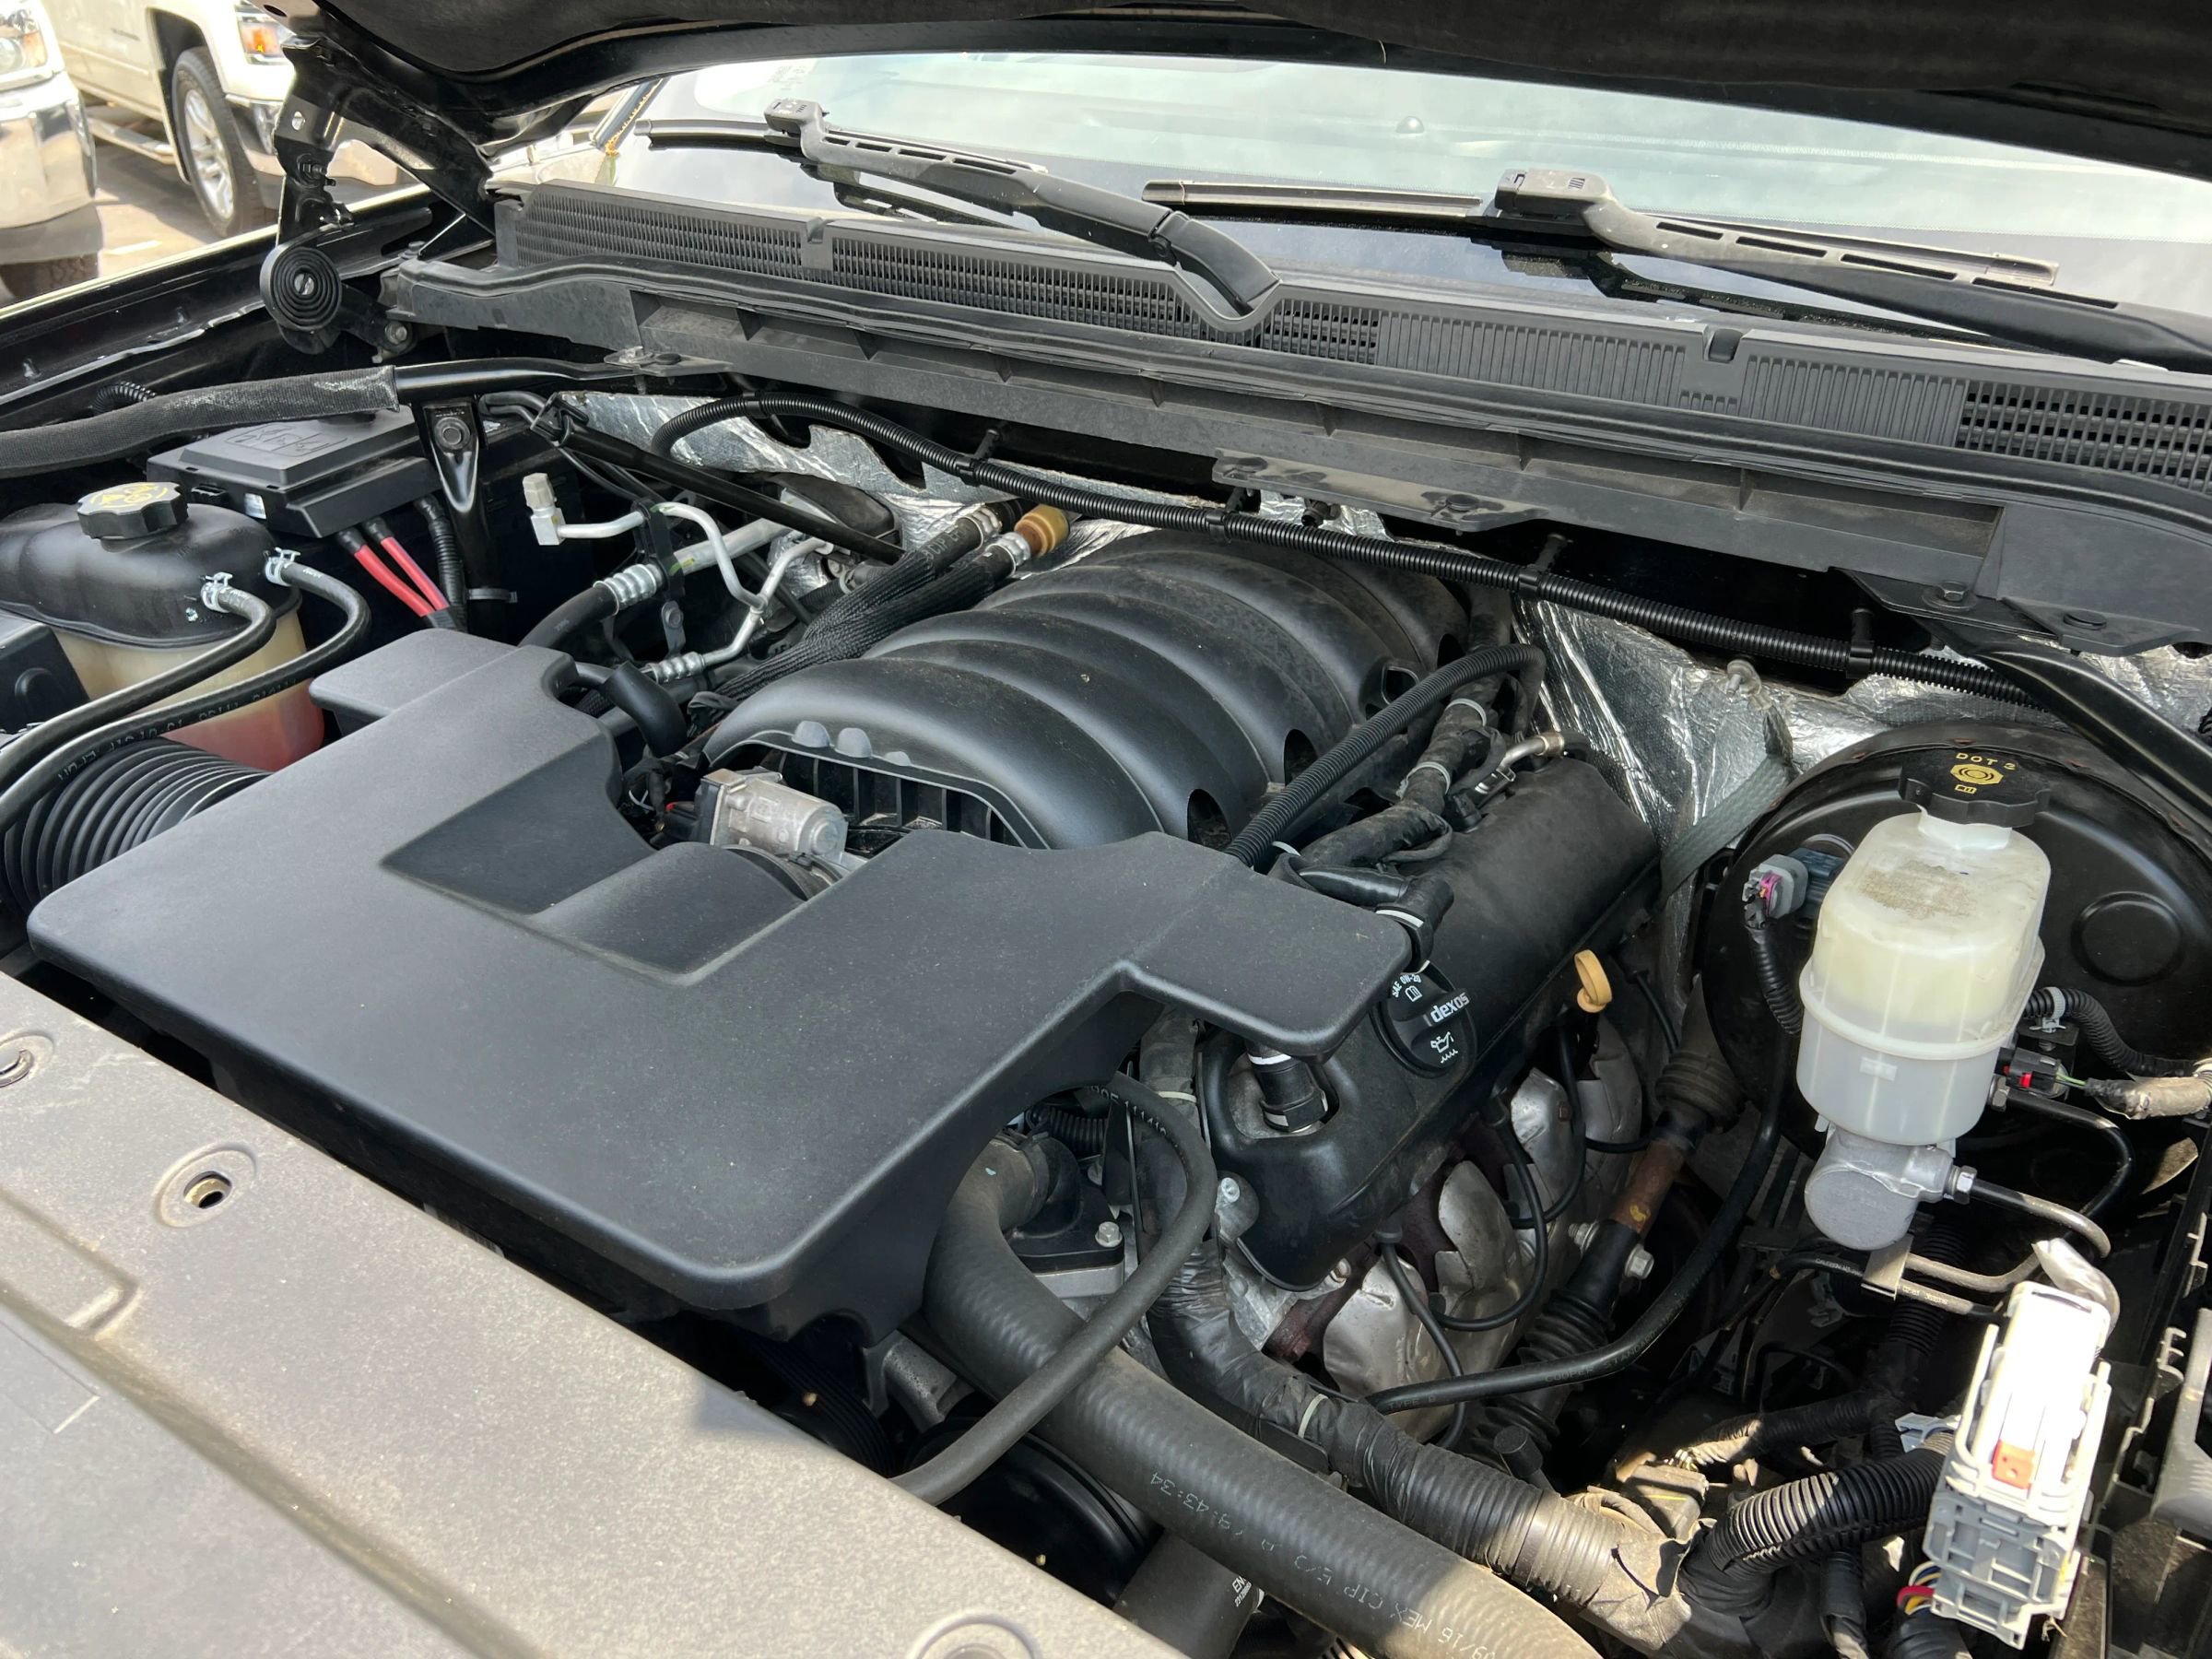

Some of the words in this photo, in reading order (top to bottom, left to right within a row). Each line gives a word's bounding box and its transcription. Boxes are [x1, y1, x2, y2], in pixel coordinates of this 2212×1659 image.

[1956, 752, 1998, 765] DOT
[1392, 981, 1402, 998] SAE
[1400, 973, 1422, 985] 0W-20
[1430, 992, 1471, 1023] dexos
[1344, 1584, 1383, 1610] CIP
[1389, 1602, 1432, 1635] MEX
